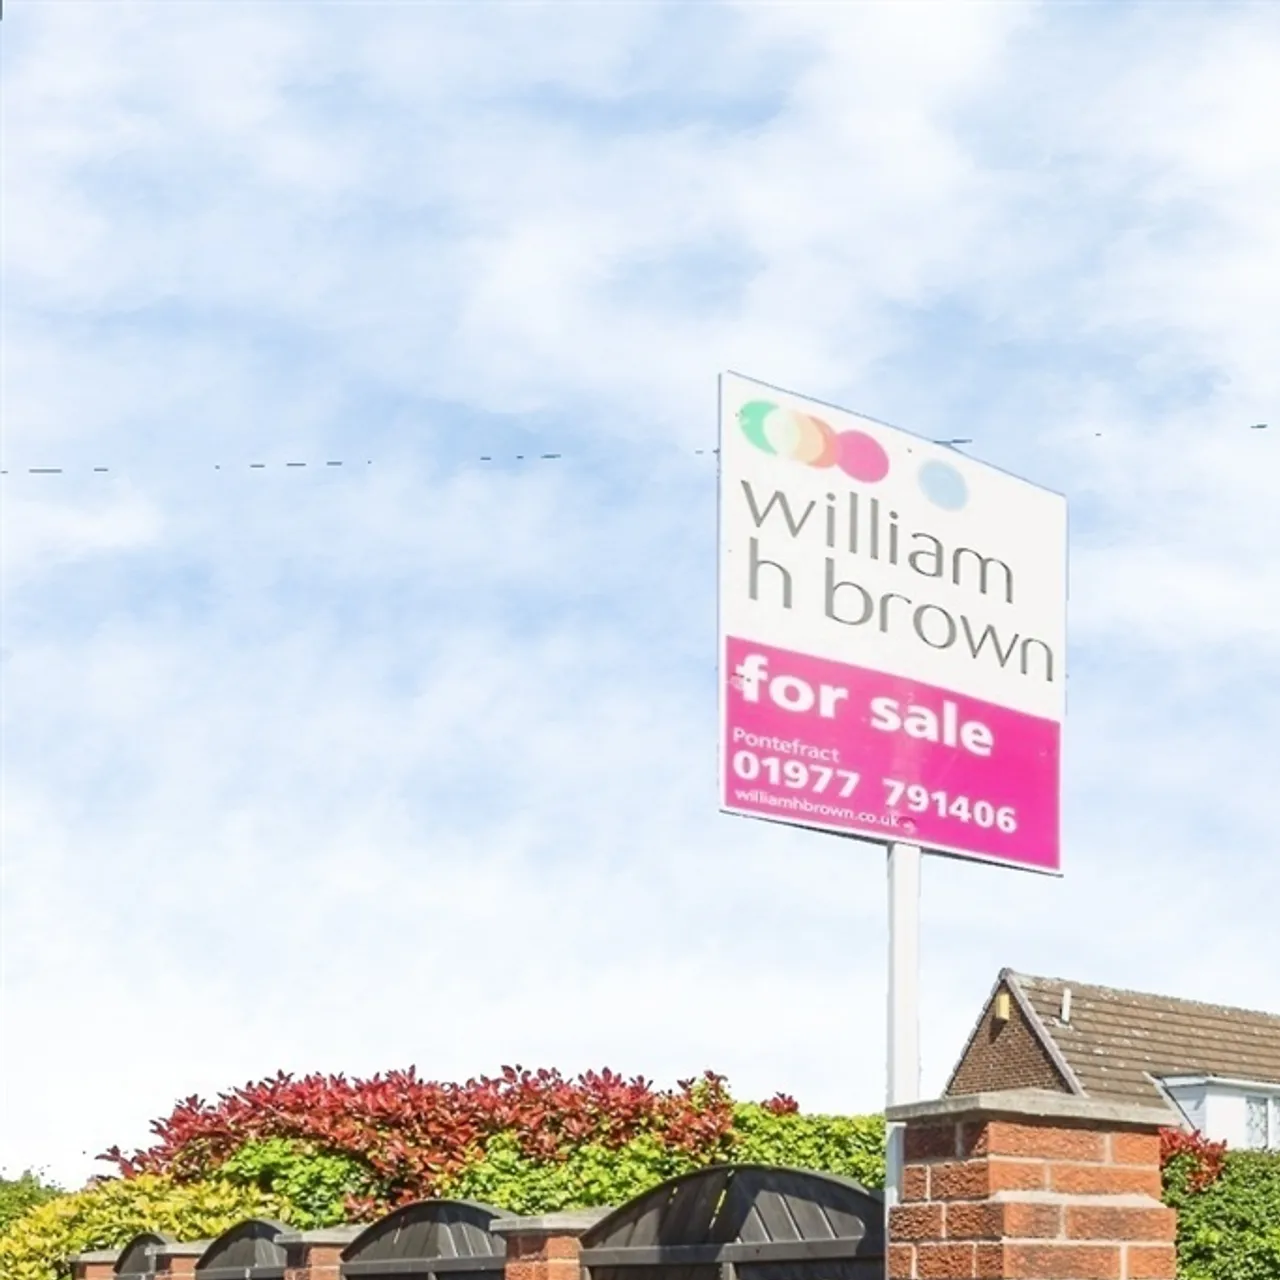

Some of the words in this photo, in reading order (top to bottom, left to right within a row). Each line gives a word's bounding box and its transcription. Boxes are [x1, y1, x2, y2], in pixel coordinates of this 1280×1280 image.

[741, 479, 1013, 604] william
[749, 536, 793, 610] h
[824, 556, 1053, 682] brown
[733, 727, 840, 763] Pontefract
[735, 653, 848, 719] for
[869, 696, 994, 757] sale
[733, 750, 860, 798] 01977
[882, 777, 1017, 834] 791406
[735, 789, 900, 828] williamhbrown.co.uk
